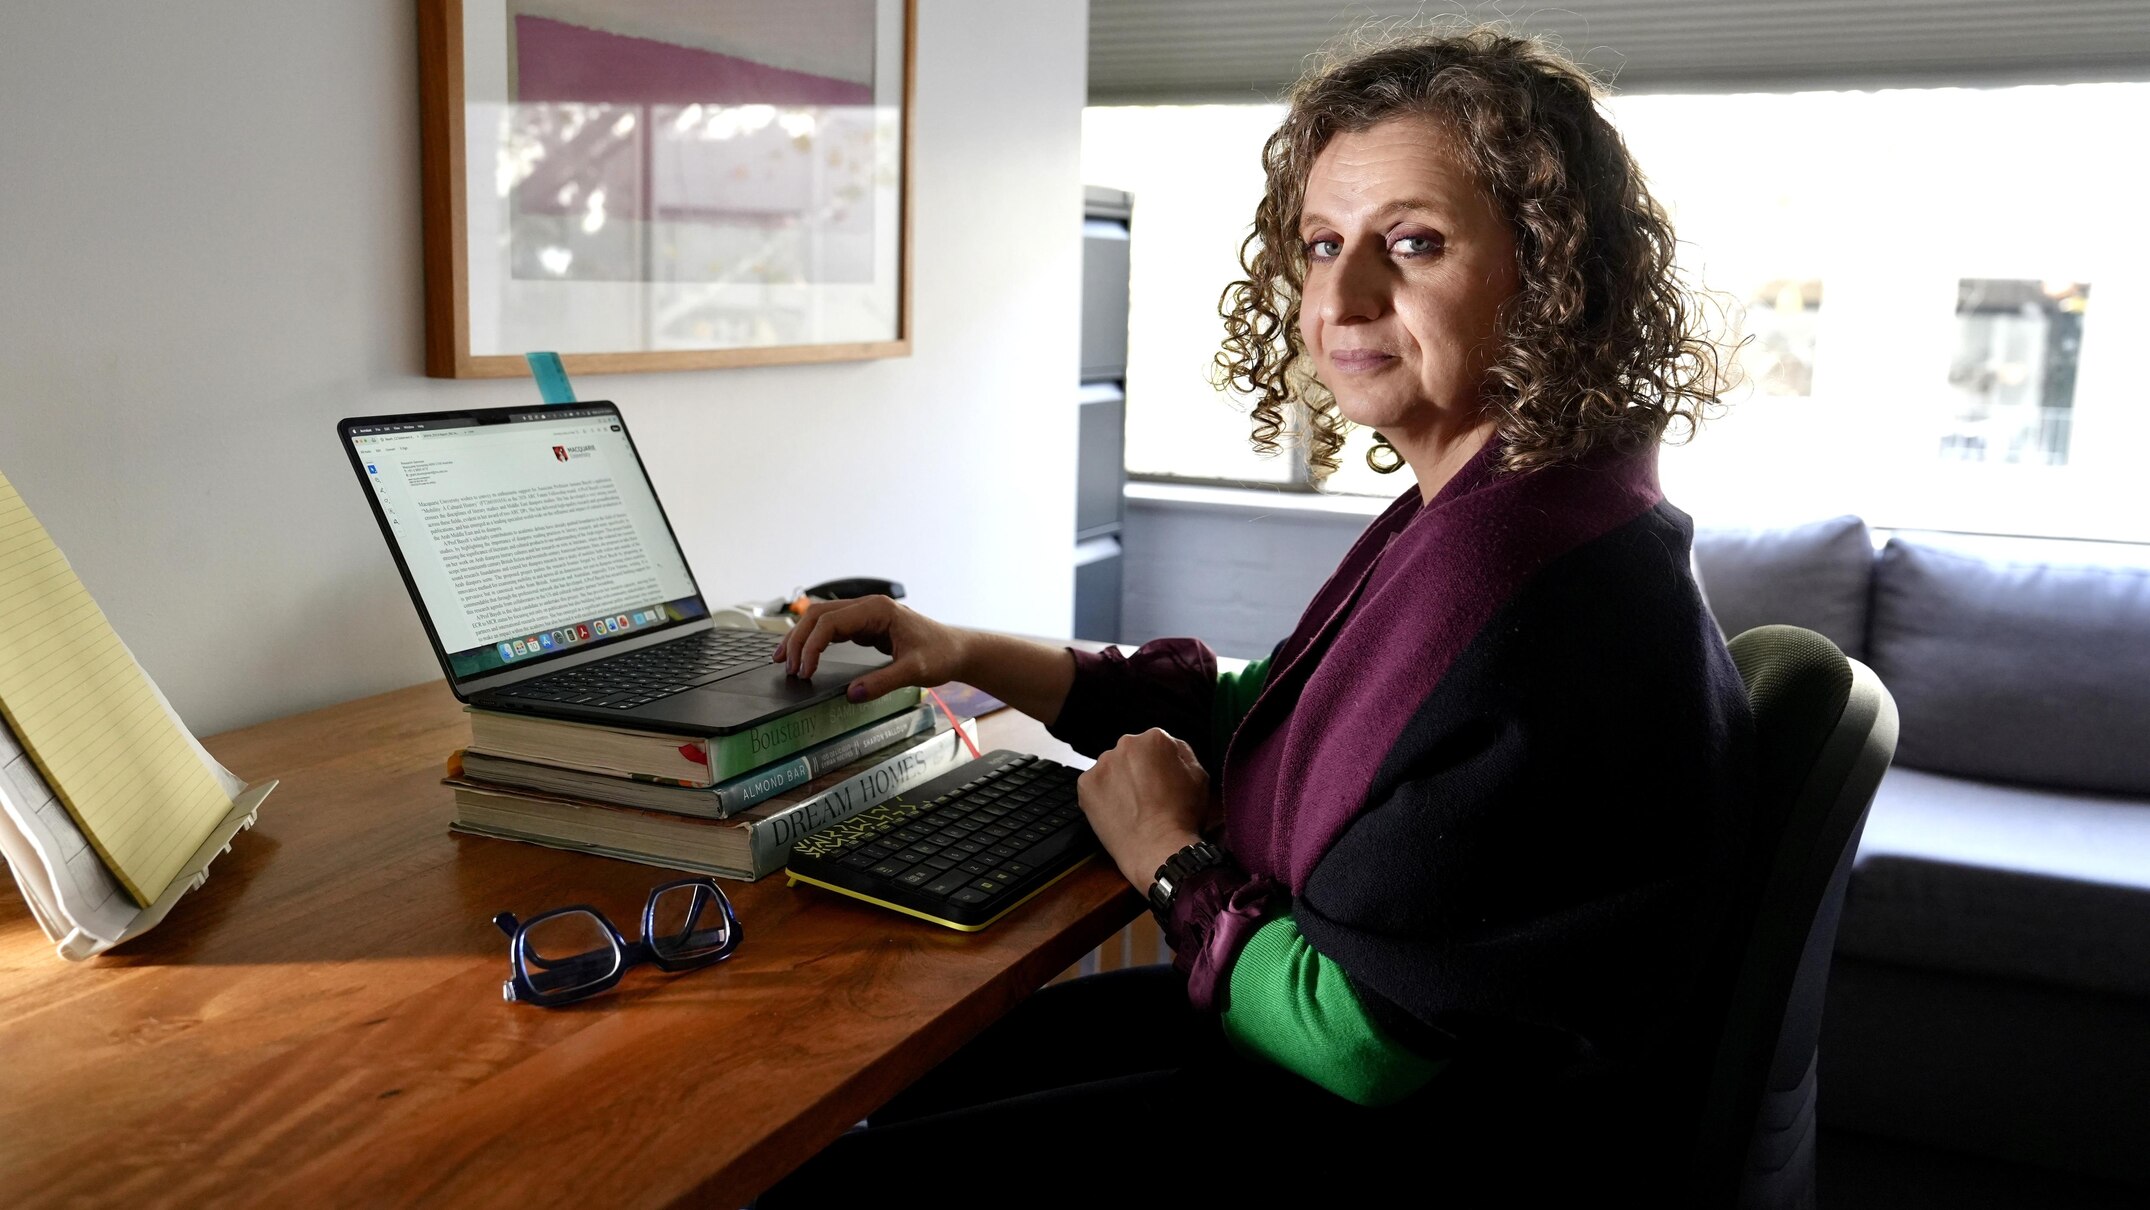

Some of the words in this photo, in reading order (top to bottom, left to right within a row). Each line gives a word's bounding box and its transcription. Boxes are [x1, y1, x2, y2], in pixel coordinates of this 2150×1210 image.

[567, 445, 596, 453] MACQUARIE
[829, 702, 856, 723] SAMI
[750, 714, 817, 753] Boustany
[863, 733, 885, 748] SHARON
[743, 772, 784, 801] ALMOND
[787, 764, 807, 781] BAR
[771, 787, 853, 847] DREAM
[859, 750, 928, 803] HOMES
